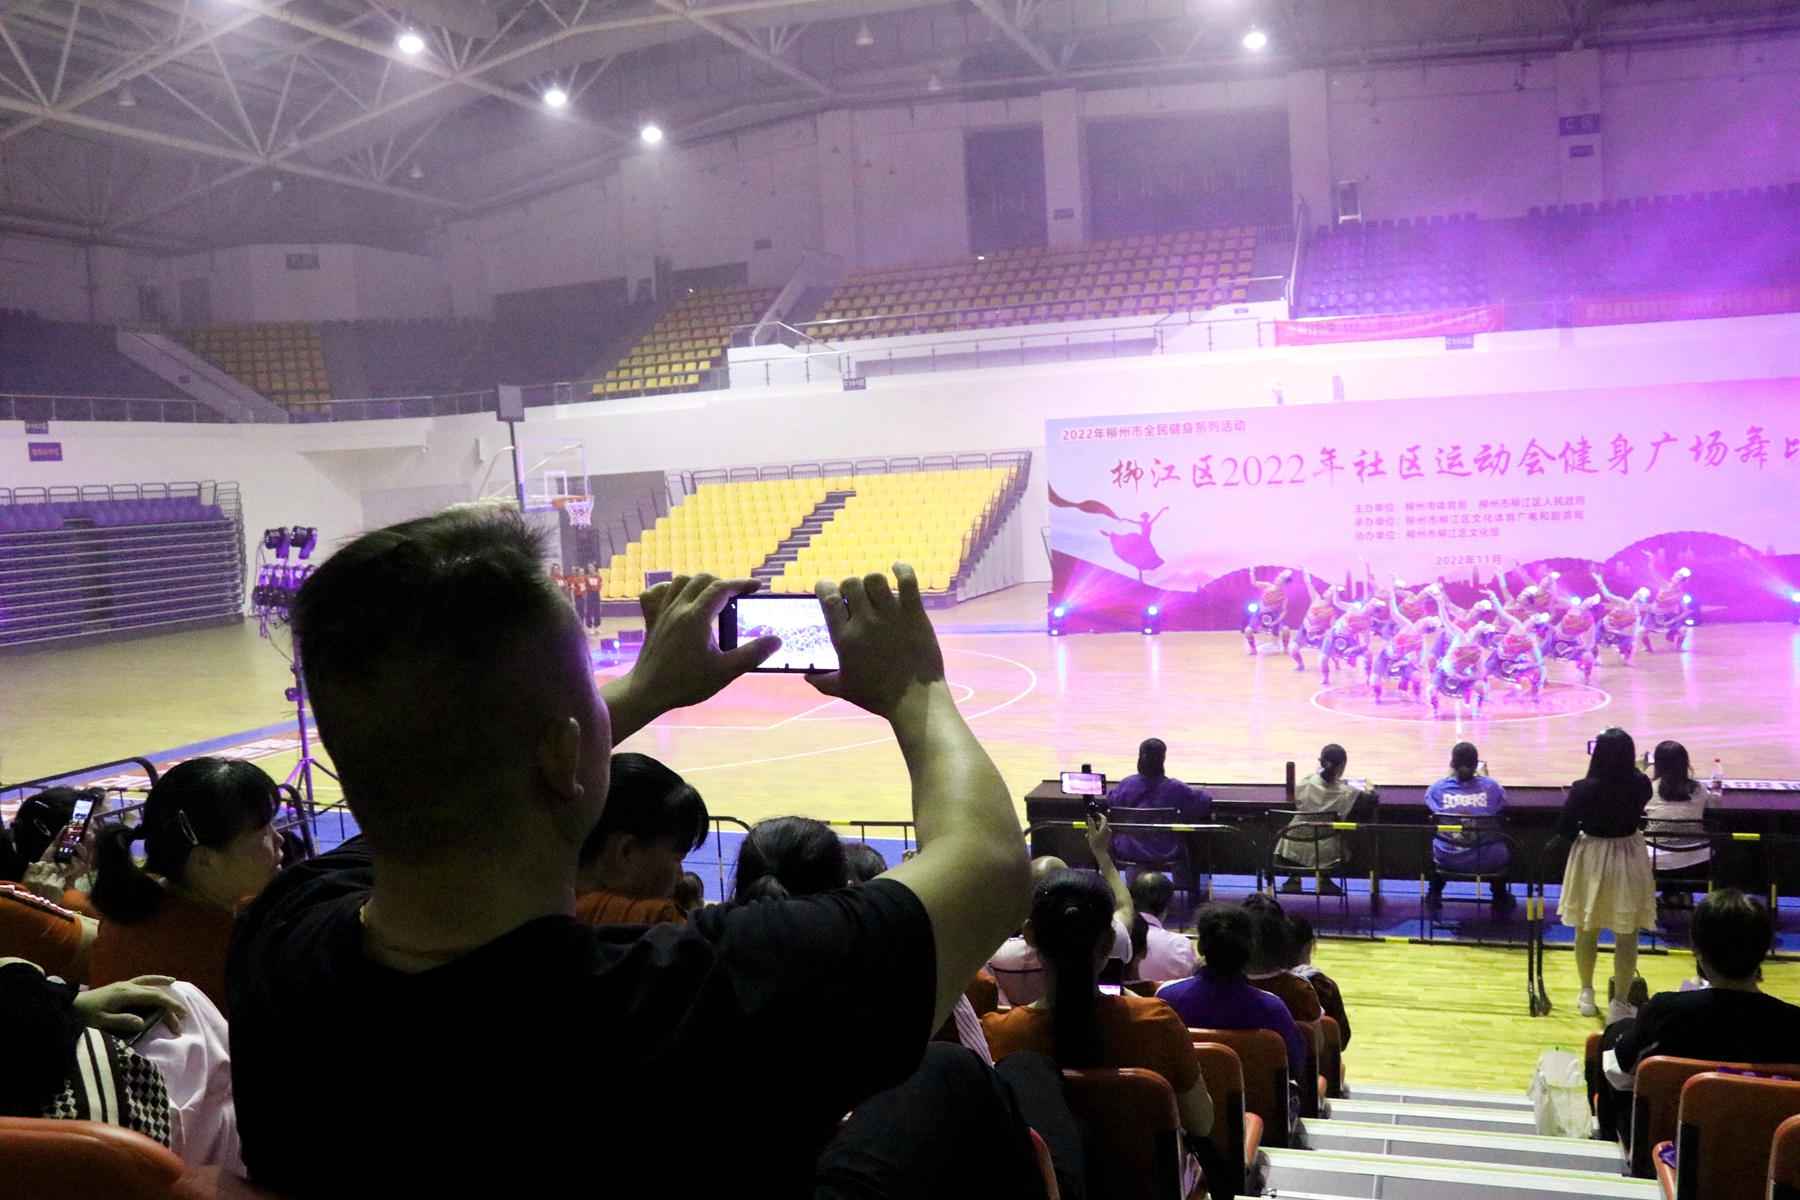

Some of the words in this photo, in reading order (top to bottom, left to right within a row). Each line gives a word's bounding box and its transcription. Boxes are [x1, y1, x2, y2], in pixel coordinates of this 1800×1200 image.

[1062, 419, 1246, 441] 2022年柳州市全民健身系列活动
[1436, 554, 1502, 566] 2022年11月
